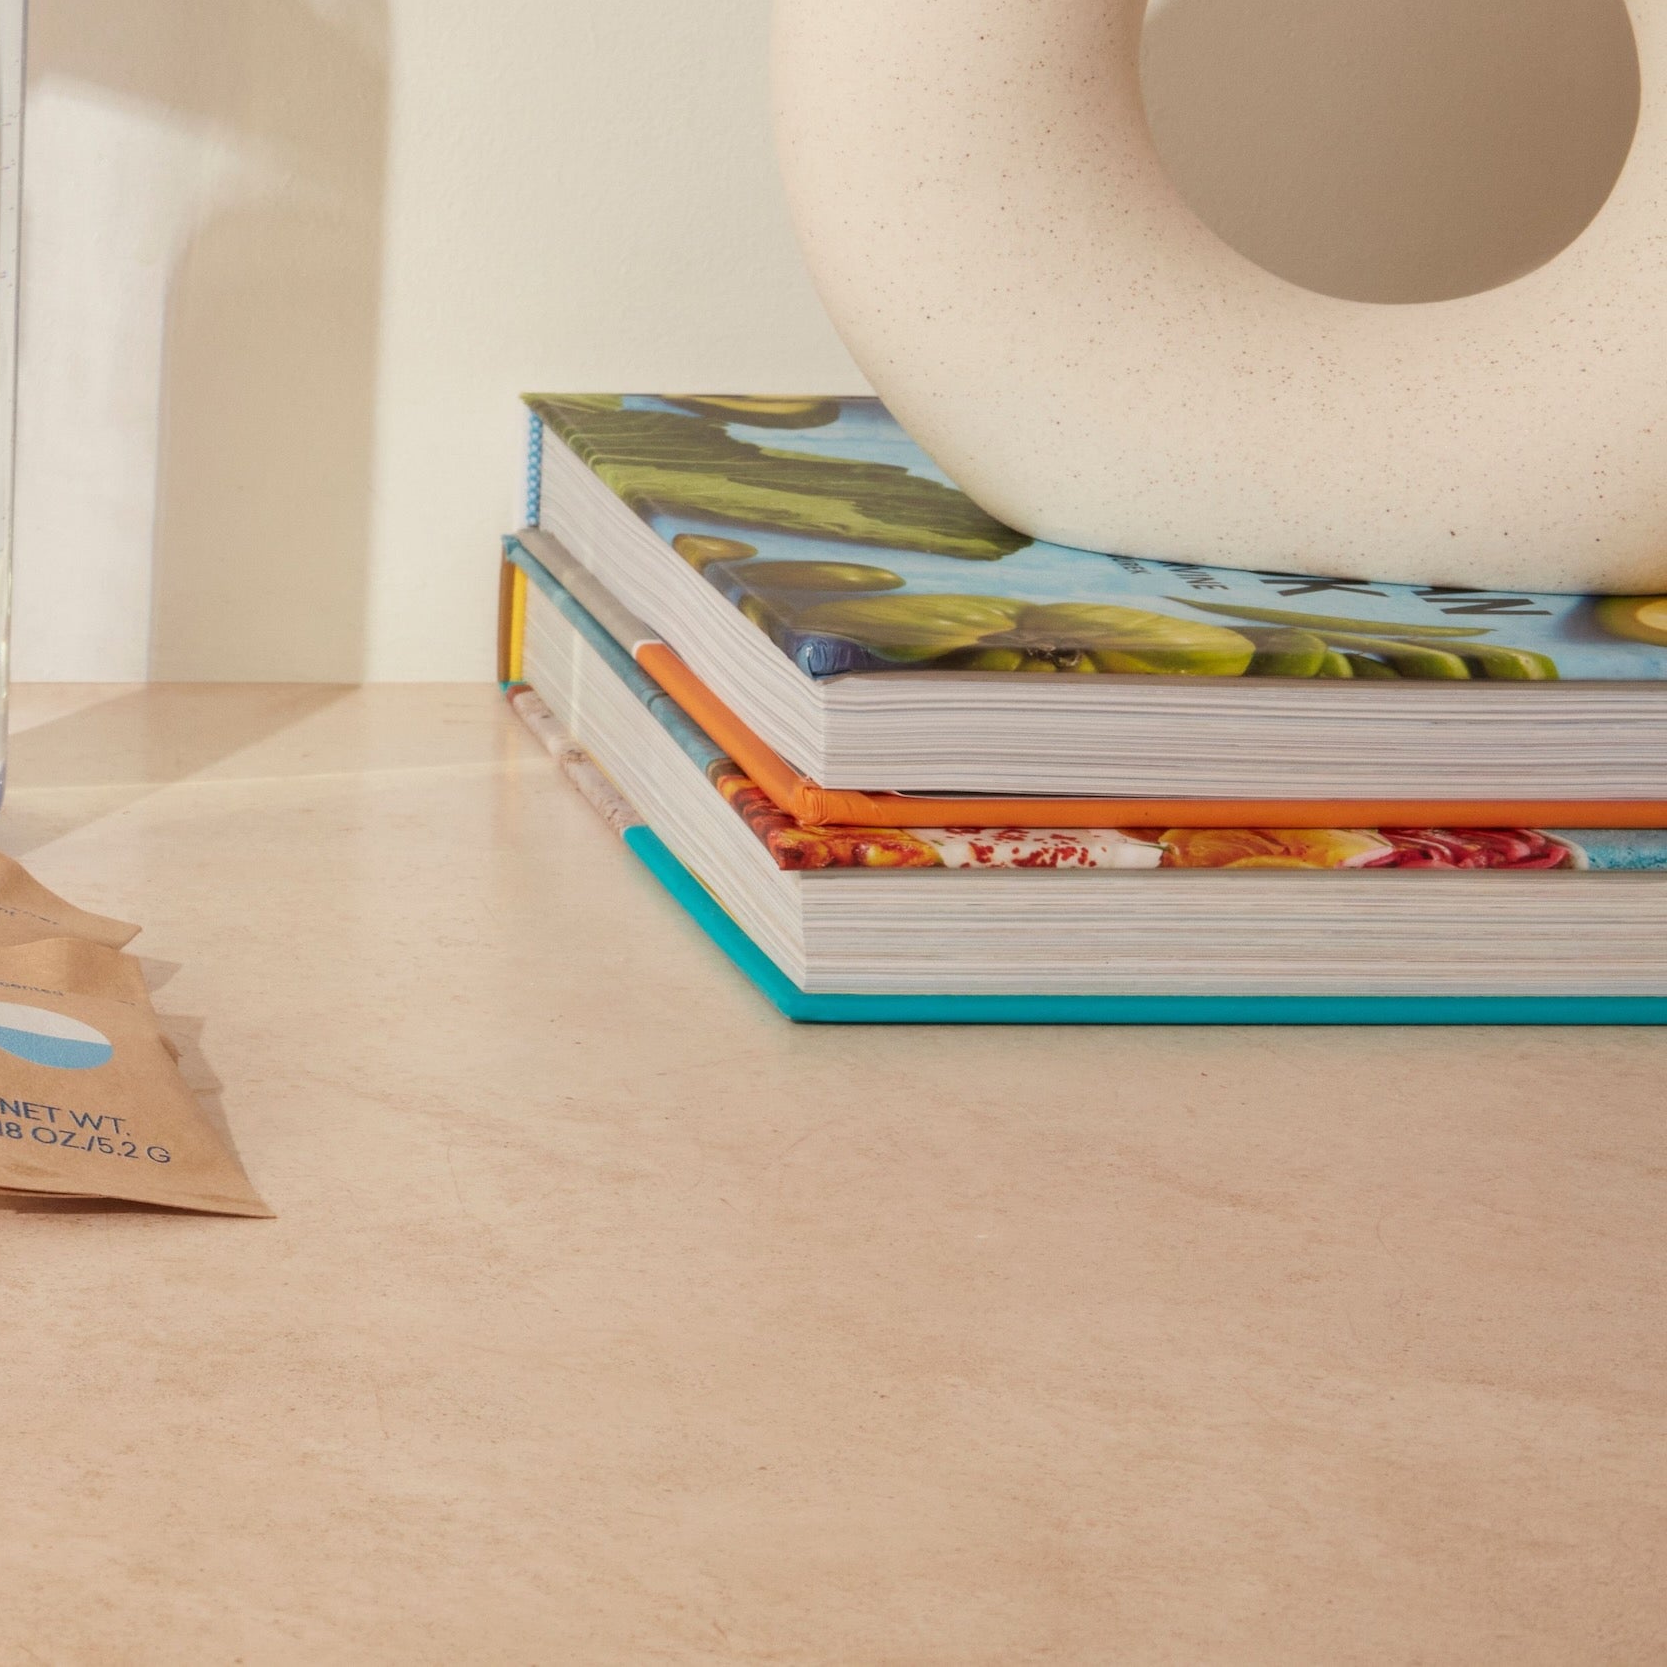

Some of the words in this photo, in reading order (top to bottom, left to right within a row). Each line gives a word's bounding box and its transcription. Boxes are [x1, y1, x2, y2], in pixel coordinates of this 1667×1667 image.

[69, 1110, 131, 1136] WT.
[31, 1126, 139, 1159] OZ./5.2
[146, 1146, 171, 1164] G
